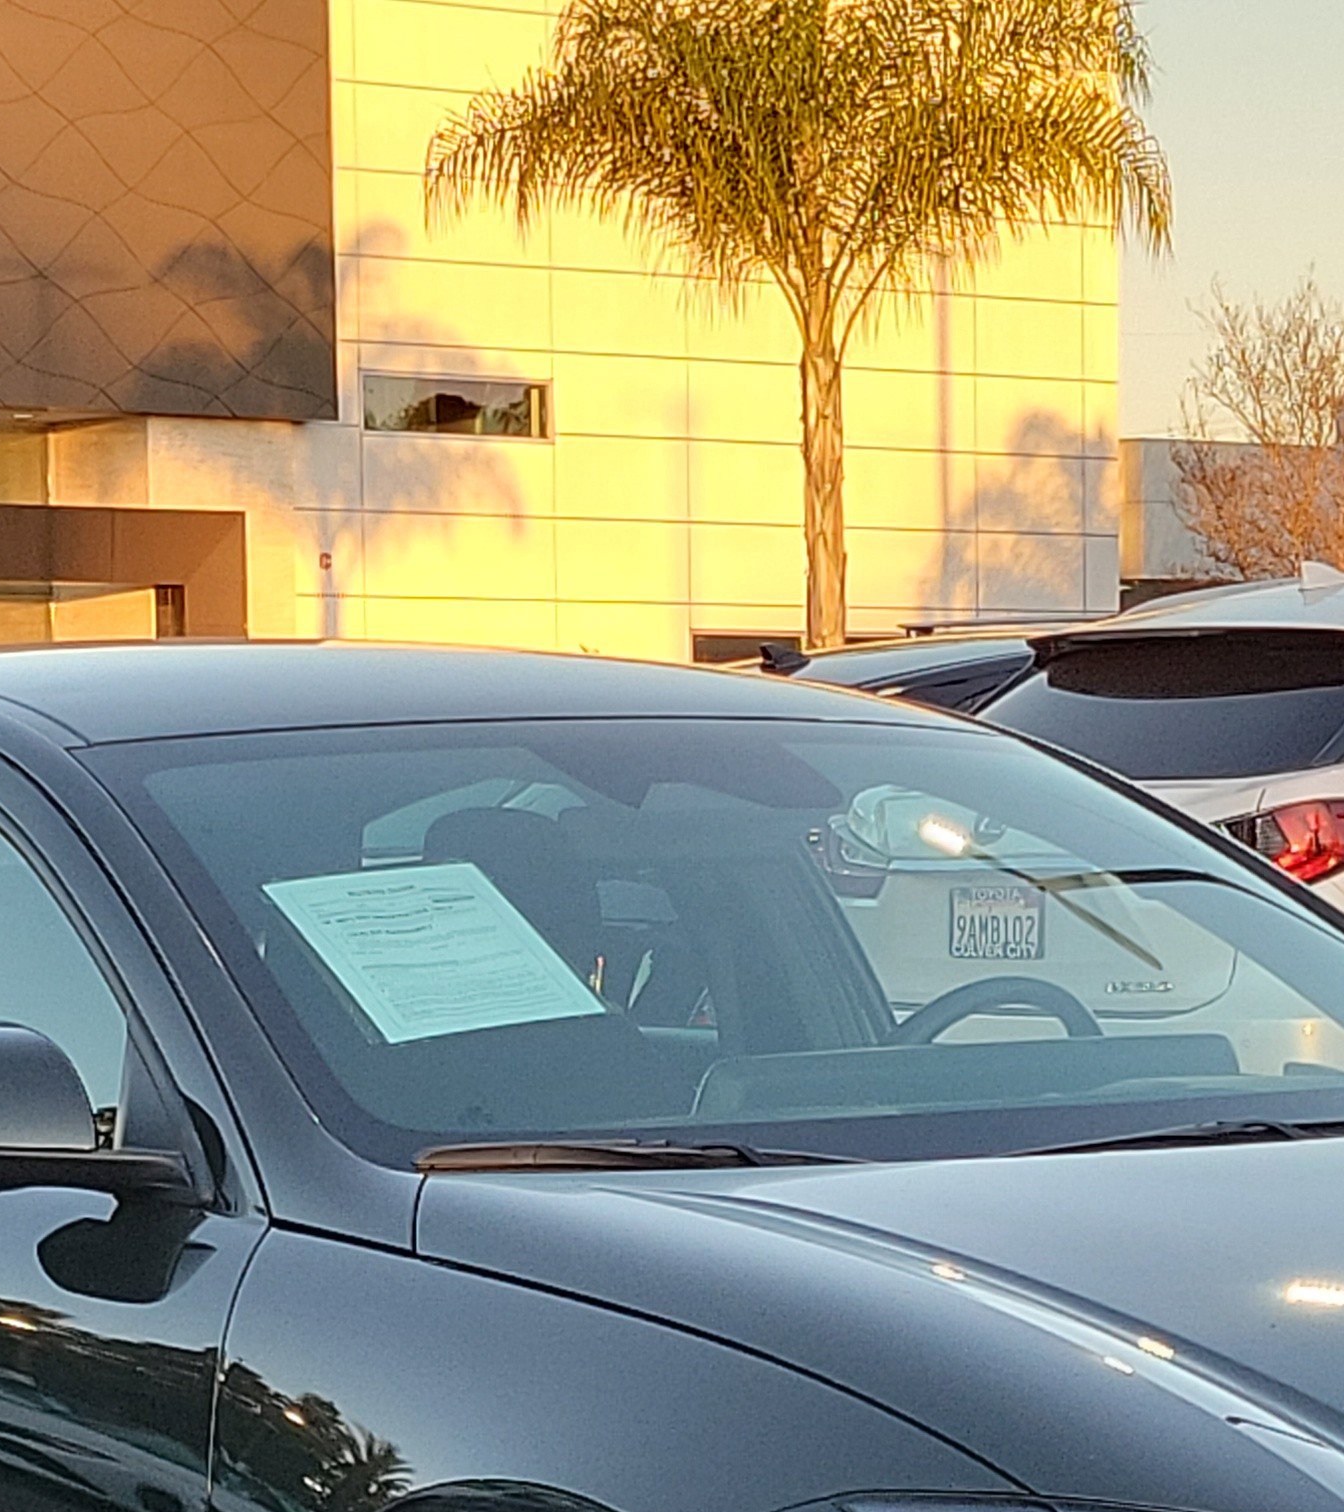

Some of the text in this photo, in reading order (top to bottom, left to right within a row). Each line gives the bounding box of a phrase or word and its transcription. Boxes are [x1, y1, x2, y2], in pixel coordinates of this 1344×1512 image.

[970, 887, 1022, 901] TOYOTA
[956, 914, 1037, 946] 9AMB102
[951, 943, 1037, 958] CULVER CITY
